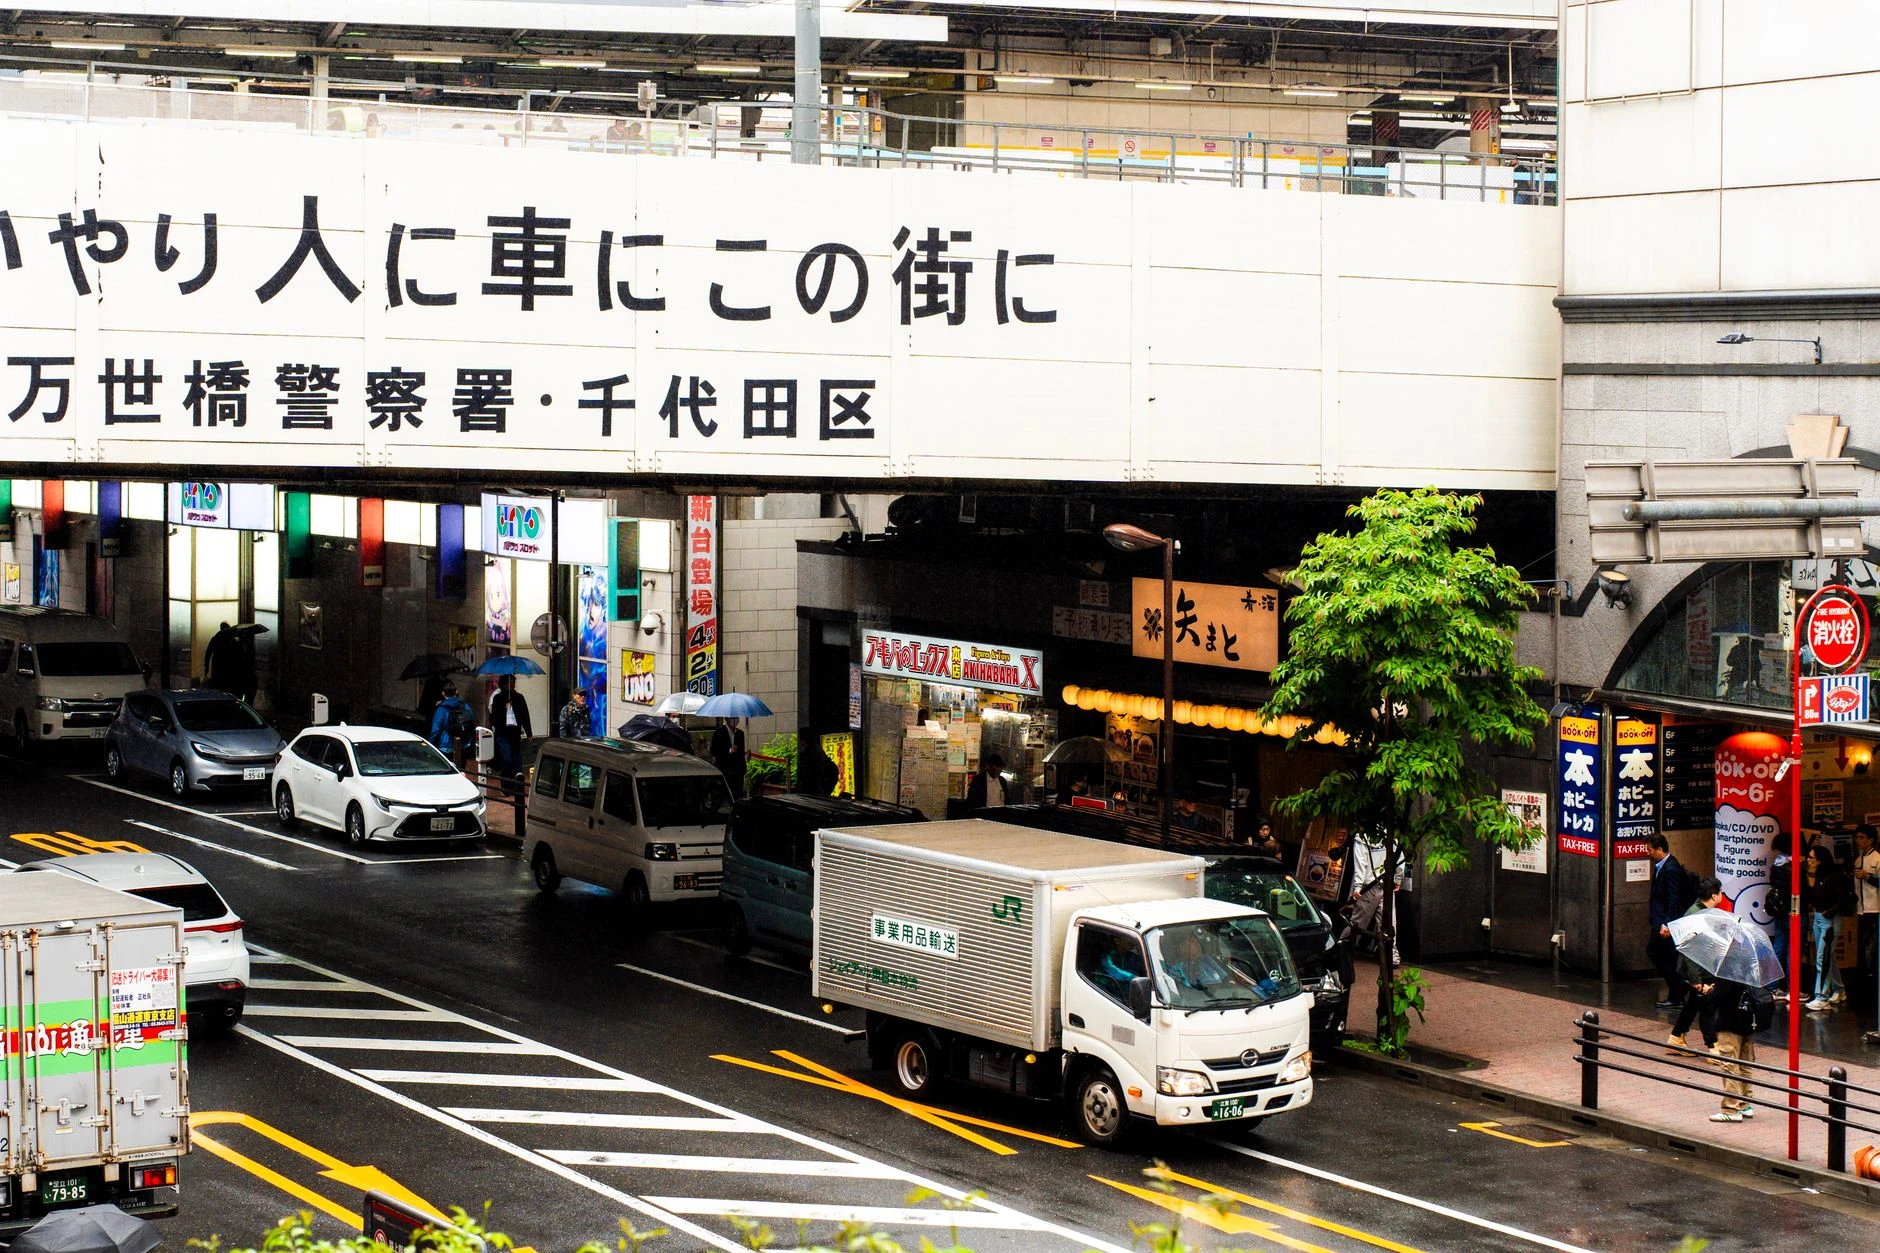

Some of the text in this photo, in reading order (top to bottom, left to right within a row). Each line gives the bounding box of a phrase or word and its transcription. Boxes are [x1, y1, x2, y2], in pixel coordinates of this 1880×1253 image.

[7, 356, 876, 441] 万世橋警察署・千代田区
[690, 496, 712, 616] 新台登場
[1817, 607, 1850, 616] FIRE HYDRANT
[1813, 619, 1855, 646] 消火栓
[865, 636, 950, 678] アキバのエックス
[951, 646, 961, 680] 本店
[962, 654, 1041, 691] AKIHABARA X
[624, 672, 654, 701] UNO
[1665, 731, 1676, 739] 6F
[1665, 748, 1676, 757] 5F
[1564, 748, 1594, 787] 本
[1619, 748, 1654, 781] 本
[1665, 765, 1675, 774] 4F
[1618, 784, 1654, 801] ホビー
[1665, 783, 1675, 792] 3F
[1563, 790, 1595, 809] ホビー
[1665, 801, 1675, 809] 2F
[1618, 801, 1654, 818] トレカ
[1563, 811, 1594, 832] トレカ
[1665, 818, 1674, 827] 1F
[1617, 825, 1655, 837] お売り下さい
[1717, 832, 1765, 845] Smartphone
[1562, 838, 1596, 853] TAX-FREE
[1617, 844, 1648, 854] TAX-FR
[1723, 844, 1751, 855] Figure
[1738, 858, 1767, 866] model
[1736, 869, 1766, 878] goods
[992, 894, 1022, 924] JR
[874, 918, 956, 954] 事業用品輸送
[1219, 1105, 1243, 1119] 16-06
[53, 1179, 78, 1188] 足立 101
[52, 1185, 86, 1202] 79-85
